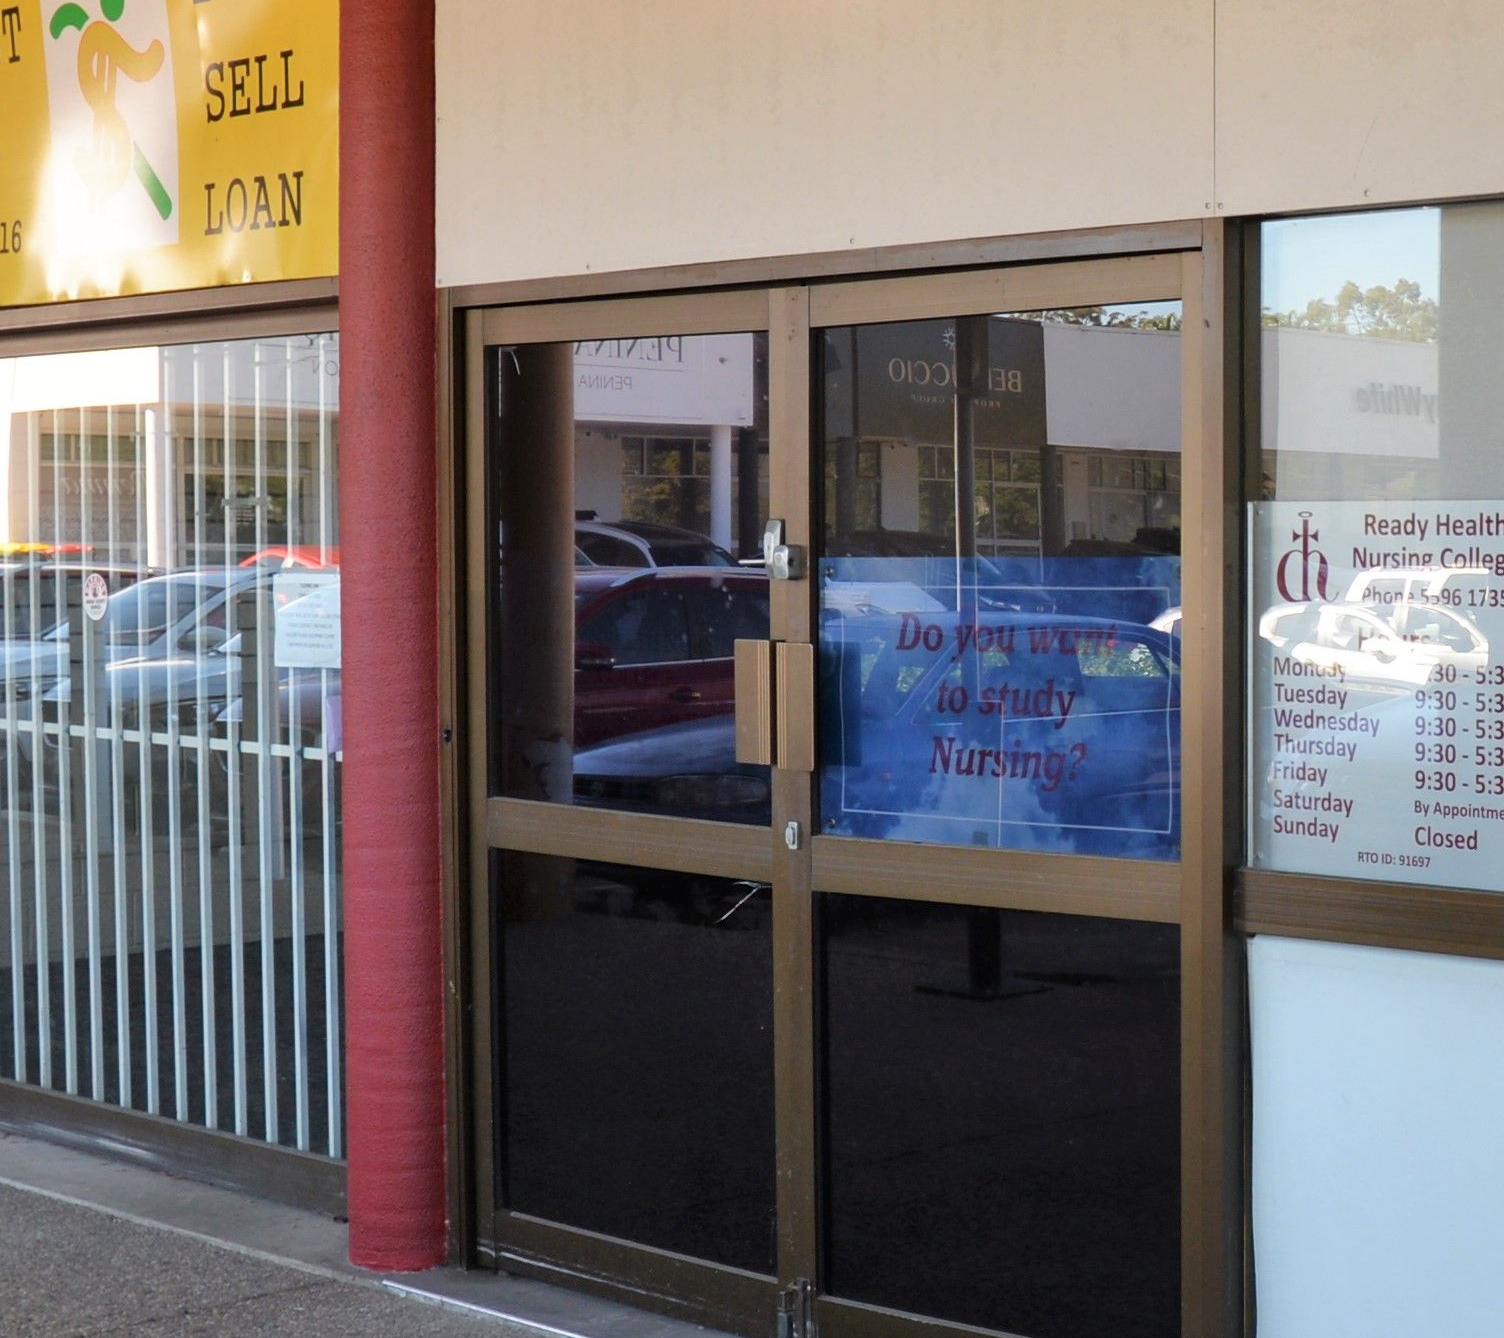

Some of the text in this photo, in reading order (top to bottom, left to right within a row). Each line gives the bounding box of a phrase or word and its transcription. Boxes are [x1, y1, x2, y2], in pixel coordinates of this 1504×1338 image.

[205, 49, 304, 124] SELL
[204, 170, 304, 236] LOAN
[1364, 513, 1429, 541] Ready
[1352, 546, 1434, 569] Nursing
[895, 611, 1119, 663] Do you want
[936, 678, 1077, 730] to study
[1273, 683, 1348, 710] Tuesday
[1414, 690, 1457, 711] 9:30
[1273, 708, 1380, 738] Wednesday
[1414, 716, 1457, 737] 9:30
[928, 735, 1088, 792] Nursing?
[1273, 733, 1357, 762] Thursday
[1414, 742, 1457, 764] 9:30
[1273, 761, 1328, 787] Friday
[1414, 770, 1457, 792] 9:30
[1273, 789, 1354, 818] Saturday
[1413, 800, 1429, 818] By
[1273, 815, 1479, 850] Sunday Closed
[1357, 851, 1431, 868] RTO ID: 91697
